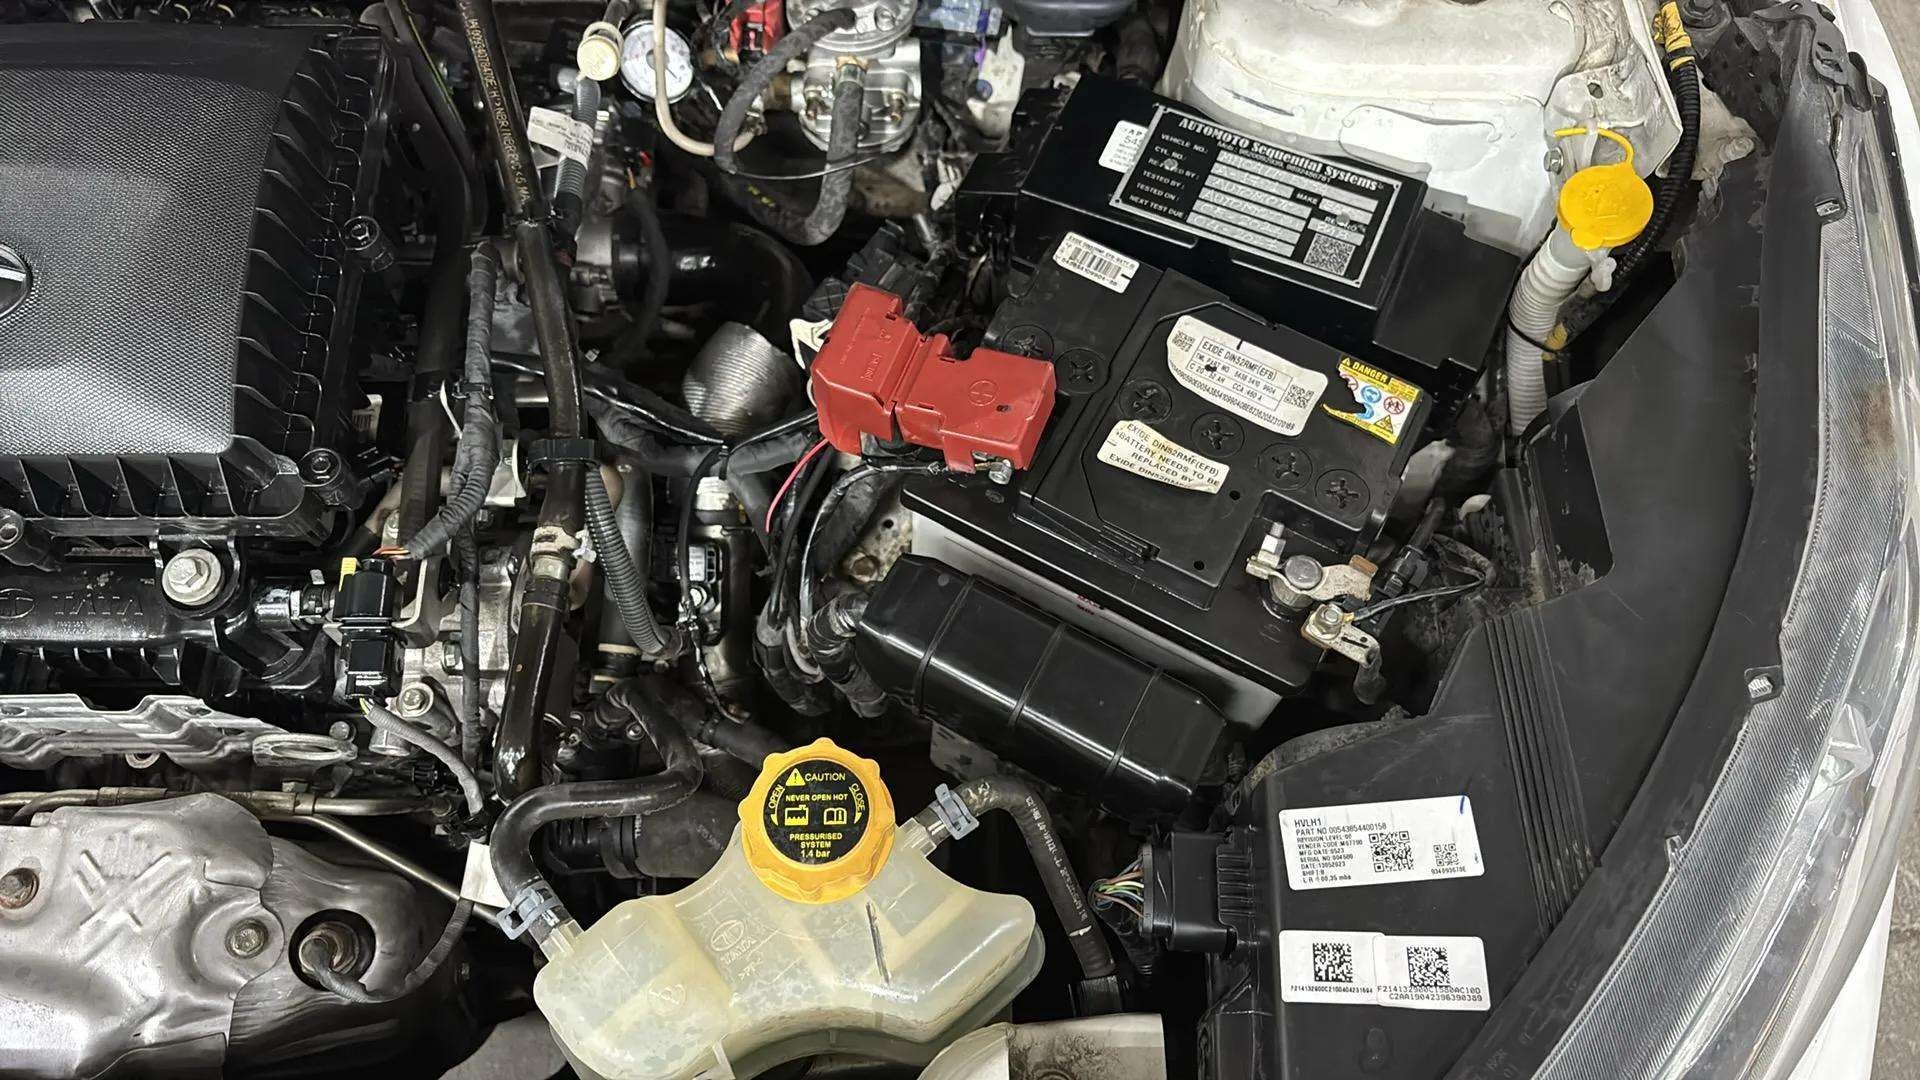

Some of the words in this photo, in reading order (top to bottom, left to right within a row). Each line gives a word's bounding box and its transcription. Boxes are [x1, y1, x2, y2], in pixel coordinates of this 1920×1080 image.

[1159, 133, 1191, 148] VEHICLE
[1177, 118, 1249, 149] AUTOMOTO
[1249, 142, 1323, 174] Sequential
[1323, 166, 1379, 191] Systems
[1141, 171, 1170, 184] TESTED
[1135, 182, 1163, 196] TESTED
[1128, 194, 1149, 206] NEXT
[1147, 201, 1168, 212] TEST
[1295, 192, 1318, 204] MAKE
[1201, 340, 1223, 356] EXIDE
[1224, 350, 1276, 380] DIN52RMF(EFB)
[1352, 361, 1388, 383] DANGER
[1232, 382, 1244, 393] CCA
[1126, 423, 1150, 441] EXIDE
[1152, 439, 1219, 476] DIN52RMF(EFB)
[1109, 453, 1135, 468] EXIDE
[1131, 452, 1177, 476] REPLACED
[1180, 474, 1193, 483] BY
[1158, 454, 1188, 472] NEEDS
[1192, 470, 1204, 479] TO
[1205, 476, 1220, 487] BE
[768, 784, 783, 808] OPEN
[850, 783, 865, 811] CLOSE
[1294, 818, 1322, 827] HVLH1
[789, 832, 842, 840] PRESSURISED
[1295, 828, 1314, 836] PART
[800, 849, 813, 857] 1.4
[815, 849, 830, 857] bar
